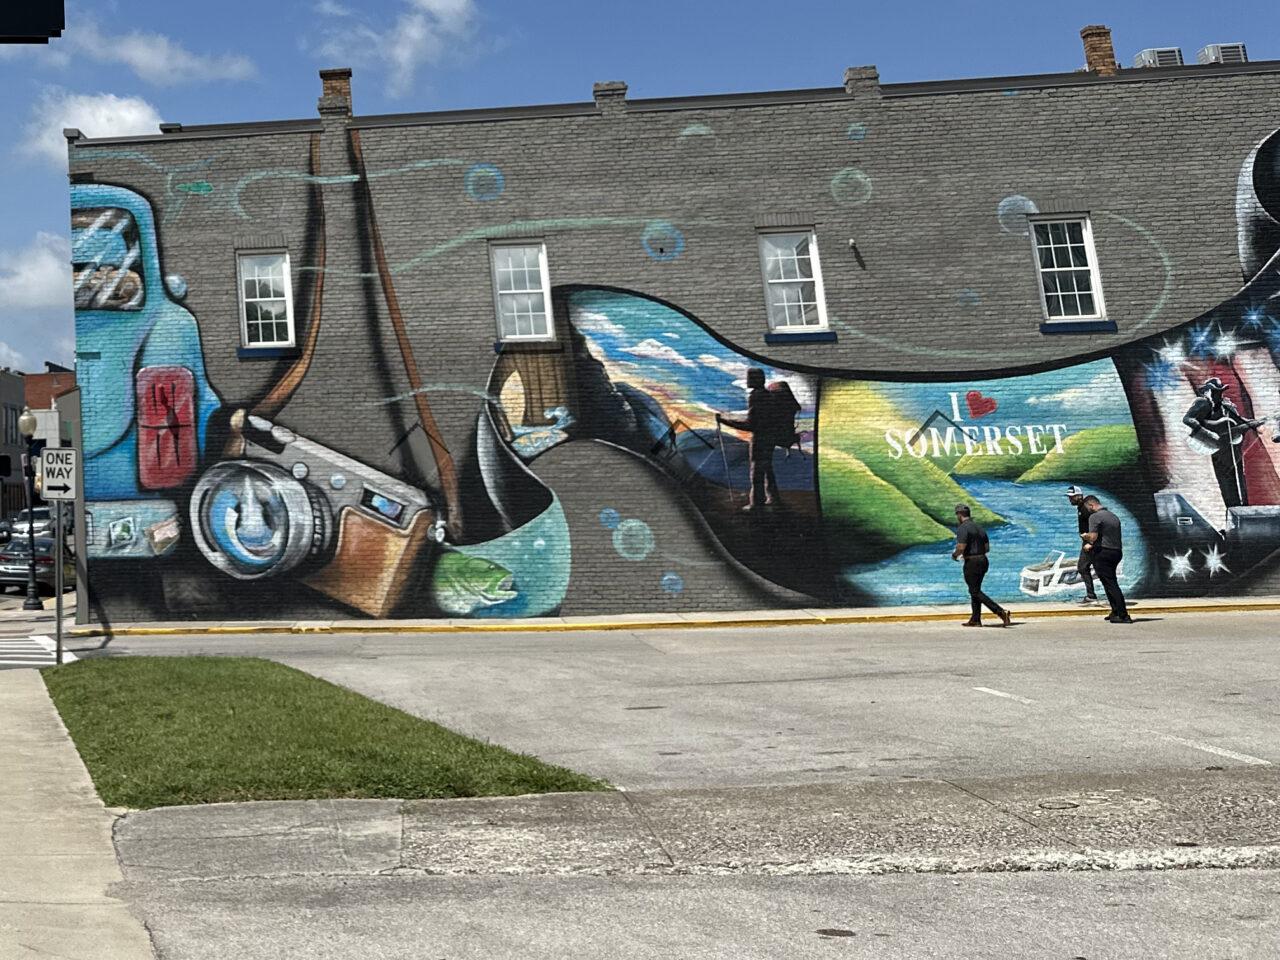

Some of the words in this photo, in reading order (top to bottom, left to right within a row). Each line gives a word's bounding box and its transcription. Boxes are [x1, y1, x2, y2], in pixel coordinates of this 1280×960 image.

[948, 392, 963, 422] I
[885, 424, 1068, 459] SOMERSET
[46, 452, 73, 465] ONE
[46, 467, 73, 479] WAY
